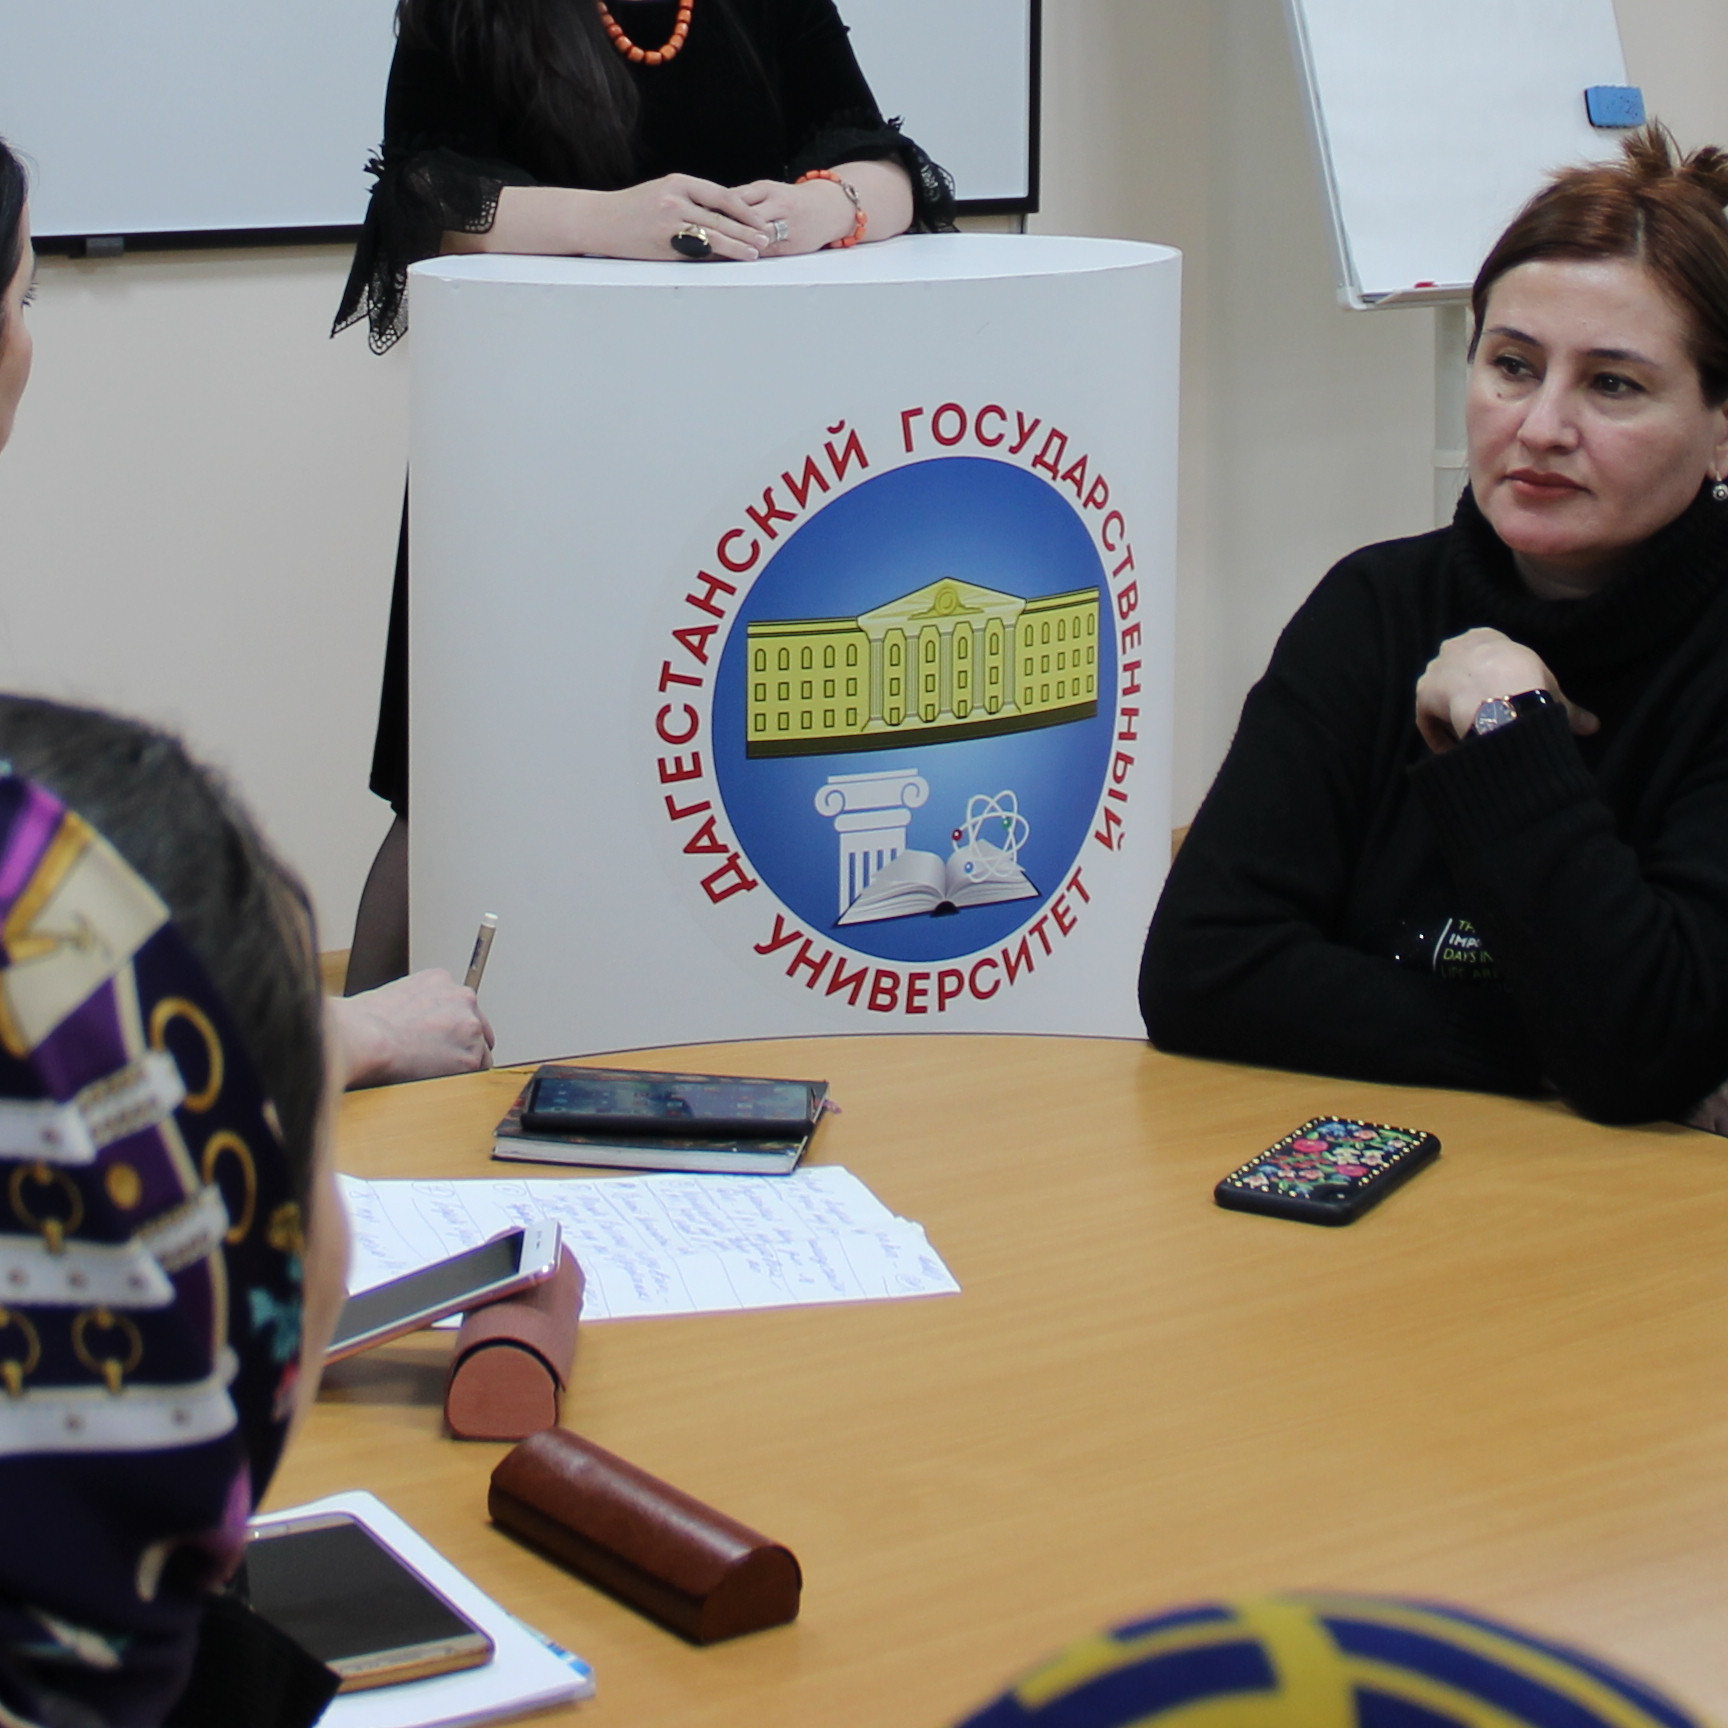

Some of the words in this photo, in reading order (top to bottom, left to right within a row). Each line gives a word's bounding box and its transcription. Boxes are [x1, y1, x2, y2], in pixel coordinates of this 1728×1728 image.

[656, 420, 870, 904] ДАГЕСТАНСКИЙ
[900, 403, 1141, 852] ГОСУДАРСТВЕННЫЙ
[754, 868, 1092, 1014] УНИВЕРСИТЕТ
